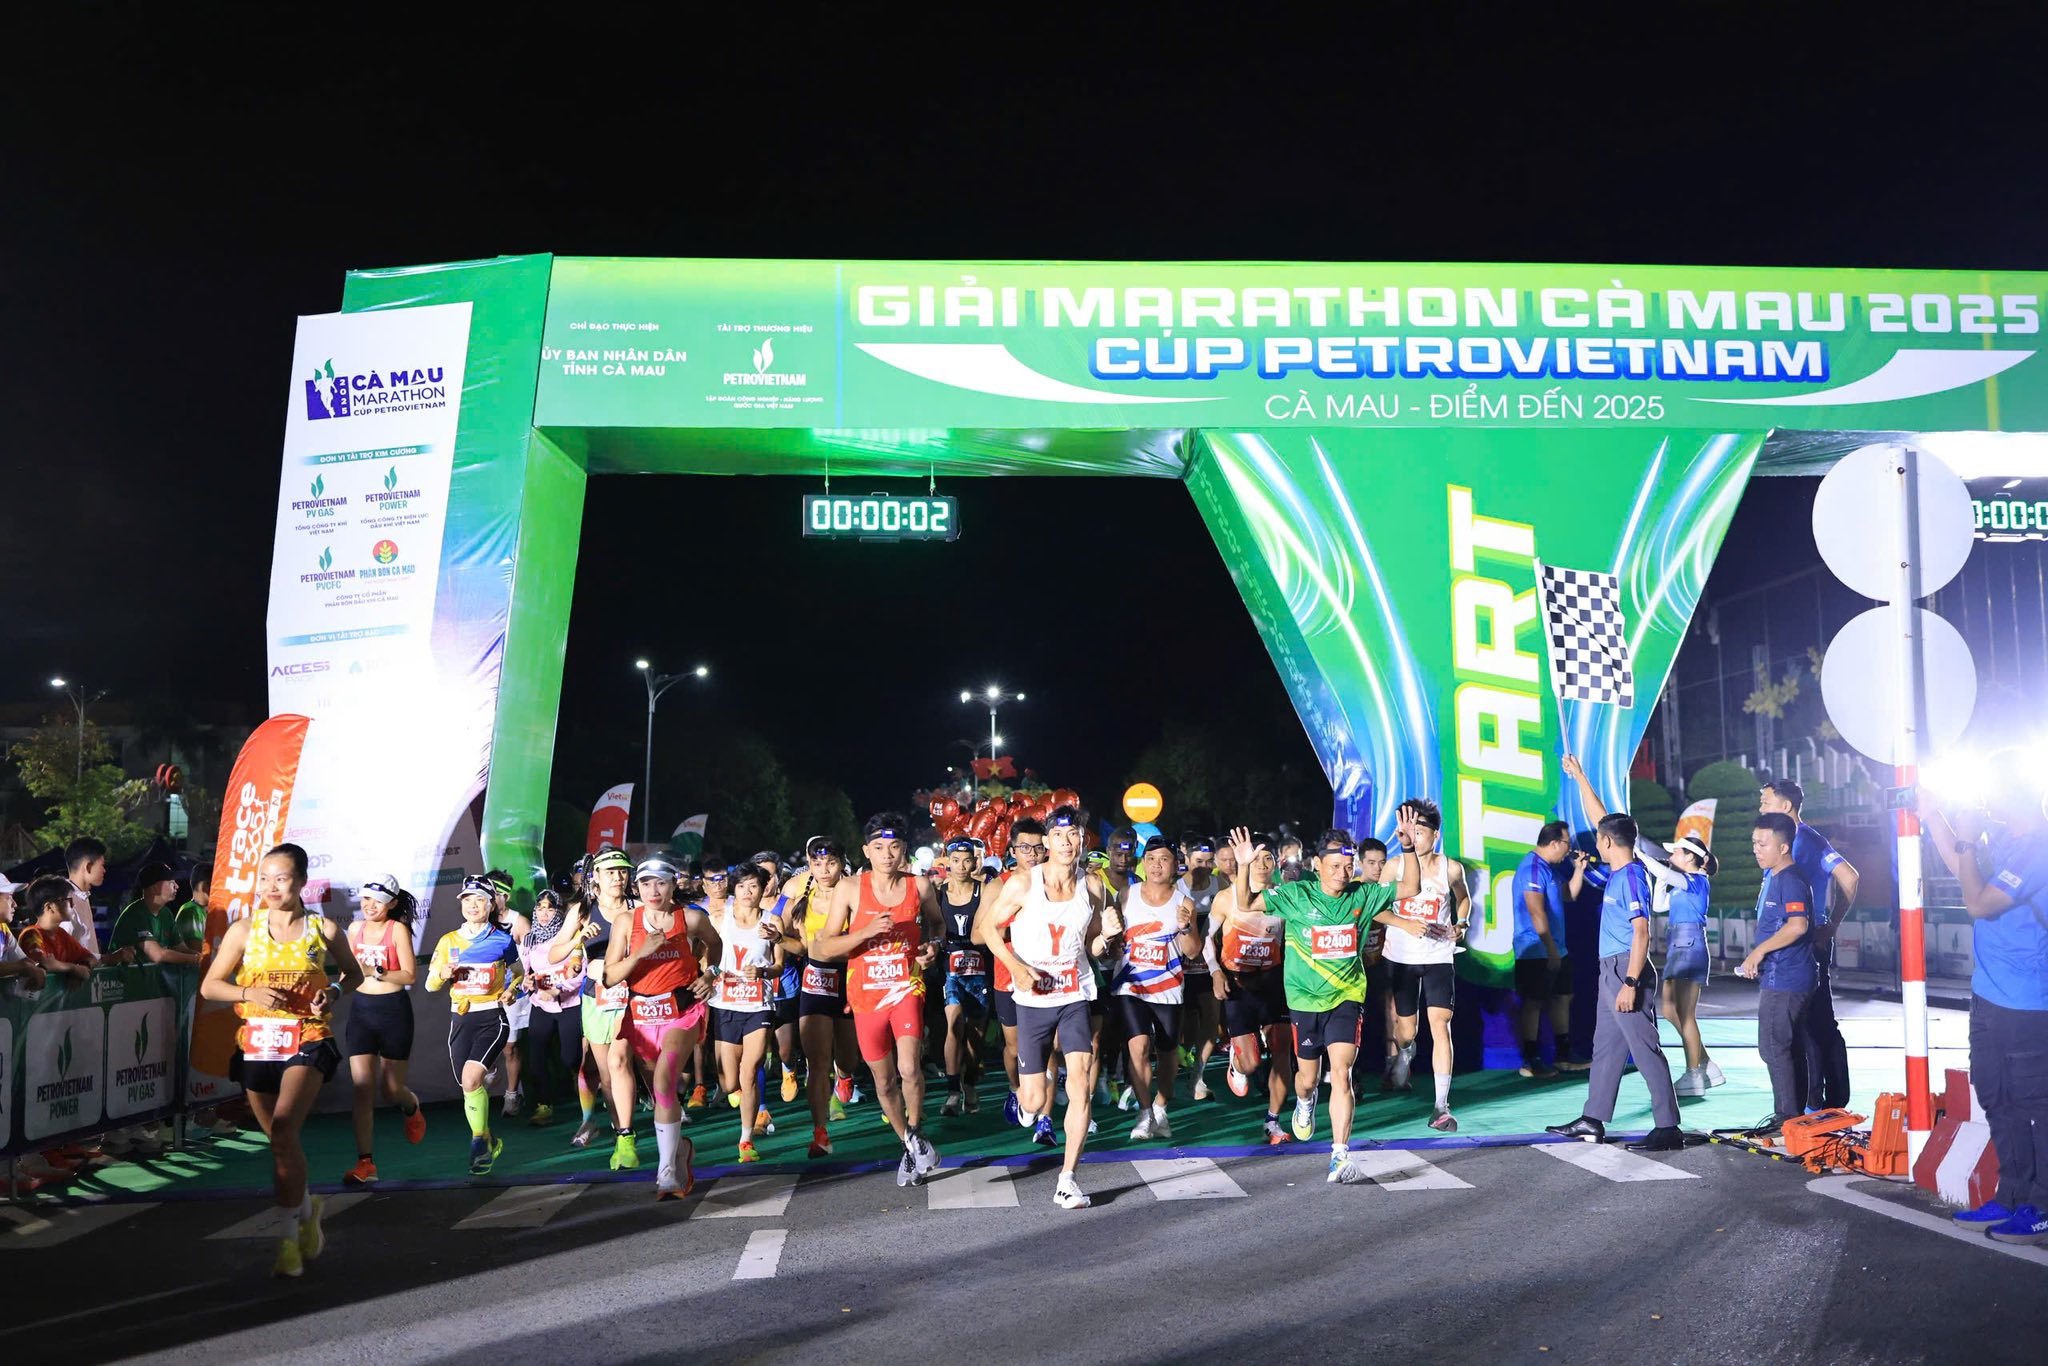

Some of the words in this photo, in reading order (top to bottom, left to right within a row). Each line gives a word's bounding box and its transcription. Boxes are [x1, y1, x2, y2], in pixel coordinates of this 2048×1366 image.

[857, 275, 1018, 328] GIẢI
[1044, 286, 1518, 328] MARATHON
[1540, 279, 1645, 329] CÀ
[1667, 290, 1846, 332] MAU
[1868, 293, 2040, 335] 2025
[566, 350, 599, 361] BAN
[603, 347, 648, 362] NHÂN
[653, 348, 687, 362] DÂN
[1095, 330, 1244, 374] CÚP
[1265, 336, 1823, 377] PETROVIETNAM
[563, 361, 598, 376] TỈNH
[602, 362, 626, 376] CÀ
[631, 365, 666, 377] MAU
[351, 370, 384, 391] CÀ
[390, 367, 443, 387] MAU
[723, 373, 806, 386] PETROVIETNAM
[353, 386, 446, 407] MARATHON
[1264, 389, 1318, 420] CÀ
[1325, 393, 1401, 420] MAU
[1429, 384, 1508, 420] ĐIỂM
[1517, 386, 1584, 420] ĐẾN
[1593, 395, 1665, 421] 2025
[353, 408, 372, 416] CÚP
[374, 401, 446, 415] PETROVIETNAM
[292, 497, 347, 511] PETROVIETNAM
[365, 489, 421, 503] PETROVIETNAM
[306, 509, 317, 519] PV
[318, 507, 335, 518] GAS
[379, 500, 408, 511] POWER
[811, 500, 949, 532] 00:00:02
[301, 569, 355, 583] PETROVIETNAM
[316, 580, 341, 591] PVCFC
[1449, 486, 1546, 955] START
[954, 914, 969, 936] Y
[1048, 923, 1066, 956] Y
[1317, 934, 1352, 949] 42400
[733, 944, 748, 971] Y
[1133, 946, 1164, 961] 42344
[1239, 944, 1270, 957] 42330
[868, 963, 904, 980] 42304
[806, 973, 834, 988] 42324
[726, 985, 758, 998] 42522
[636, 1003, 673, 1017] 42375
[116, 1061, 167, 1088] PETROVIETNAM
[37, 1075, 93, 1104] PETROVIETNAM
[128, 1086, 138, 1104] PV
[139, 1083, 155, 1100] GAS
[50, 1098, 79, 1121] POWER
